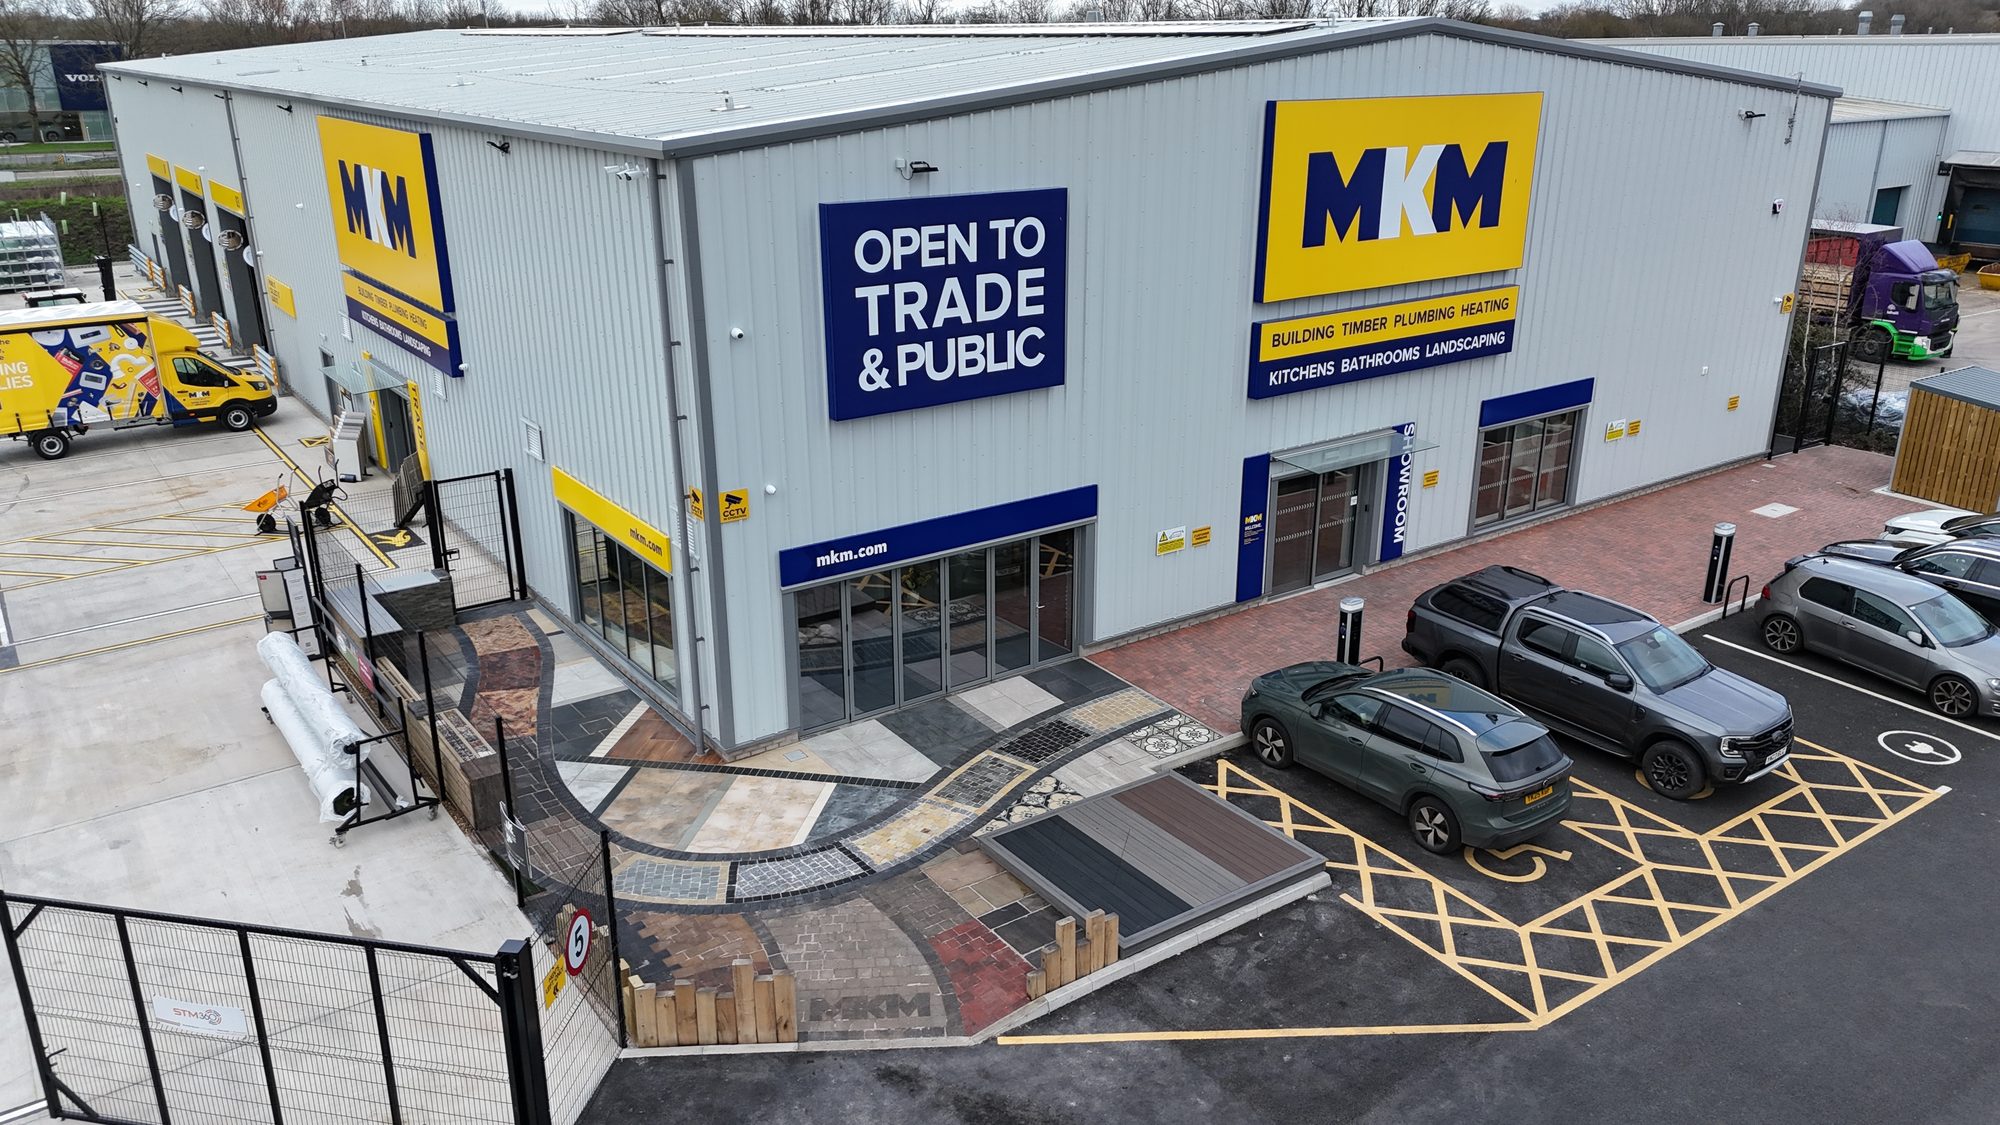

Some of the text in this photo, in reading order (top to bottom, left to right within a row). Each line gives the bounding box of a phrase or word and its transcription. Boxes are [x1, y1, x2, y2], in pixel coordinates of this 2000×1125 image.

[65, 74, 101, 82] VOL
[338, 159, 417, 259] MKM
[1302, 141, 1508, 249] MKM
[854, 216, 1046, 274] OPEN TO
[855, 267, 1045, 337] TRADE
[1271, 297, 1510, 348] BUILDING TIMBER PLUMBING HEATING
[858, 326, 1046, 392] & PUBLIC
[1268, 330, 1506, 386] KITCHENS BATHROOMS LANDSCAPING
[411, 385, 425, 452] TRADE
[1393, 423, 1415, 544] SHOWROOM
[722, 507, 747, 518] CCTV
[1244, 513, 1262, 524] MKM
[629, 527, 663, 556] mkm.com
[816, 542, 888, 568] mkm.com
[574, 924, 584, 958] 5
[810, 992, 931, 1022] MKM
